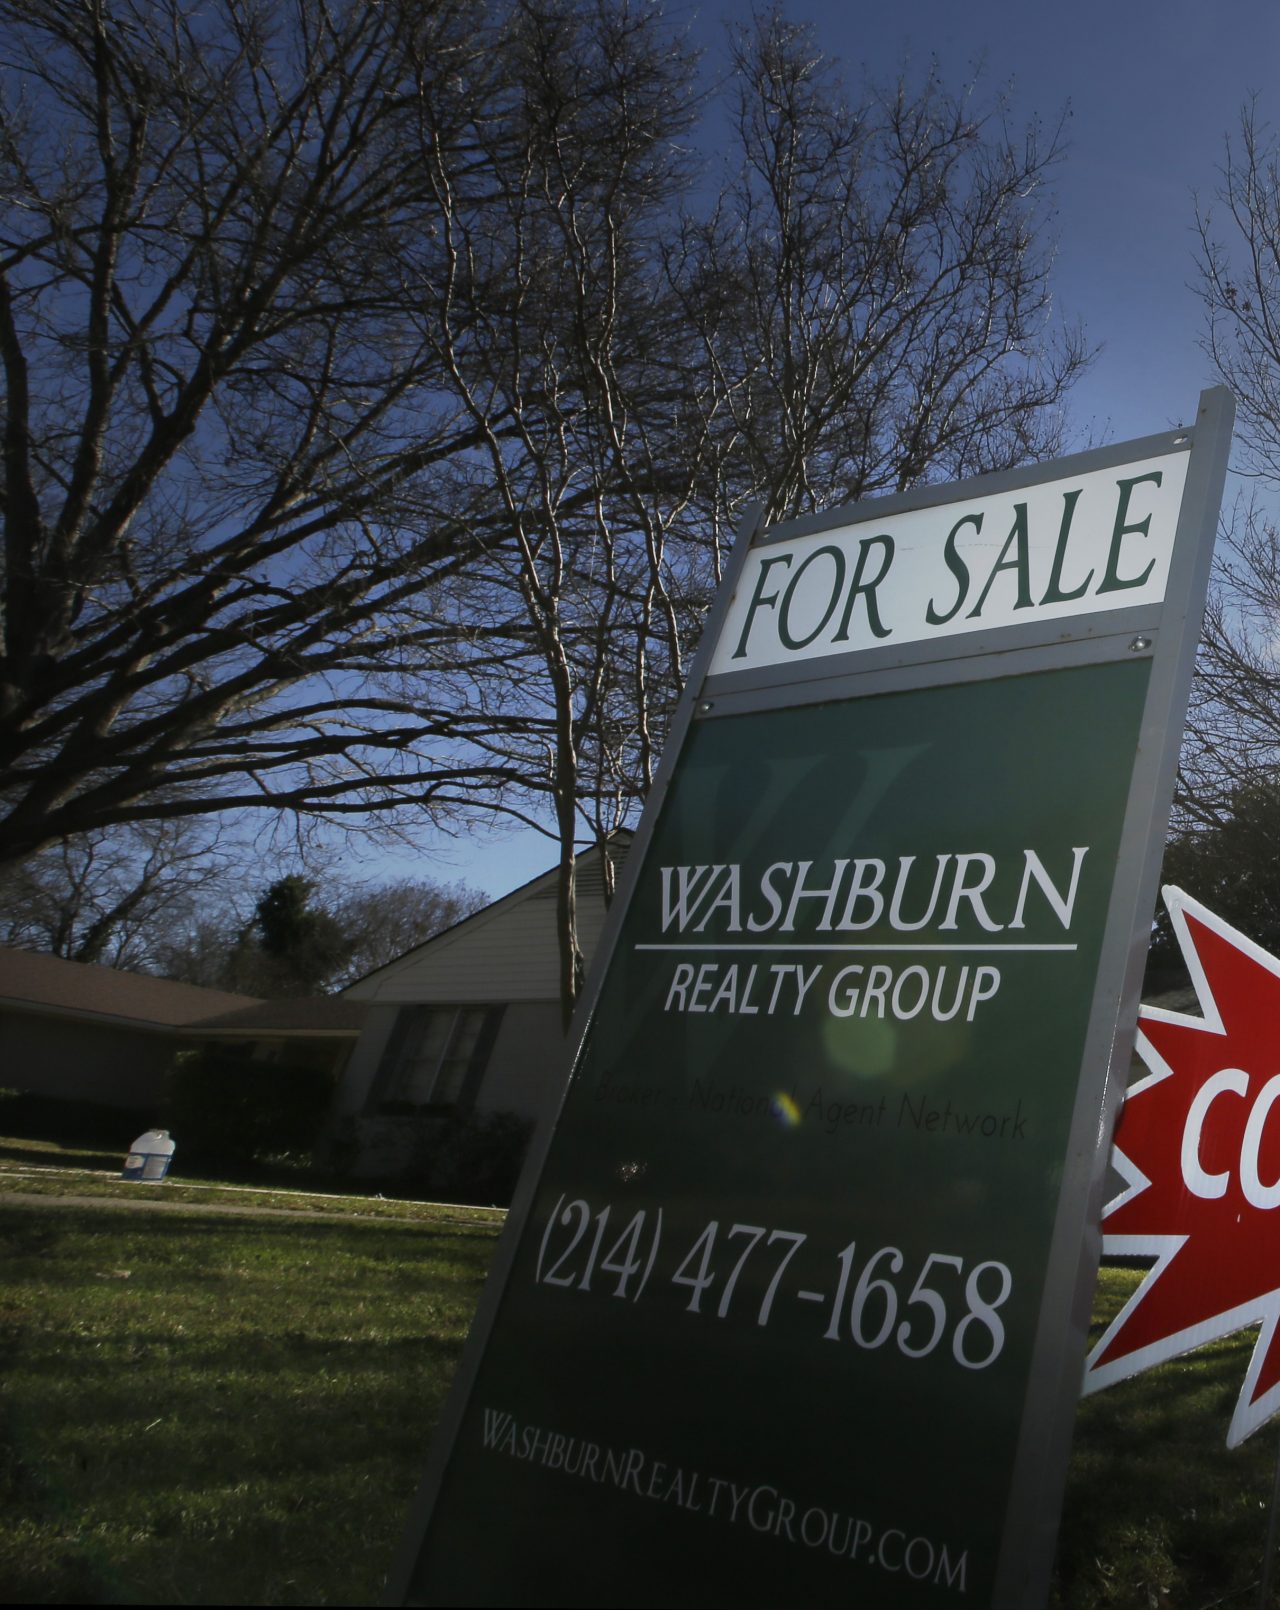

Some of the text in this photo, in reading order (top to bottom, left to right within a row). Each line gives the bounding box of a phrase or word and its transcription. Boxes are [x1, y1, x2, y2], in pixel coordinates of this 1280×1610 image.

[731, 471, 1163, 659] FOR SALE
[661, 847, 1090, 933] WASHBURN
[664, 963, 1001, 1022] REALTY GROUP
[804, 1088, 888, 1134] Agent
[897, 1092, 1030, 1140] Network
[536, 1193, 1013, 1370] (214) 477-1658
[483, 1408, 968, 1592] WASHBURNREALTYGROUP.COM
